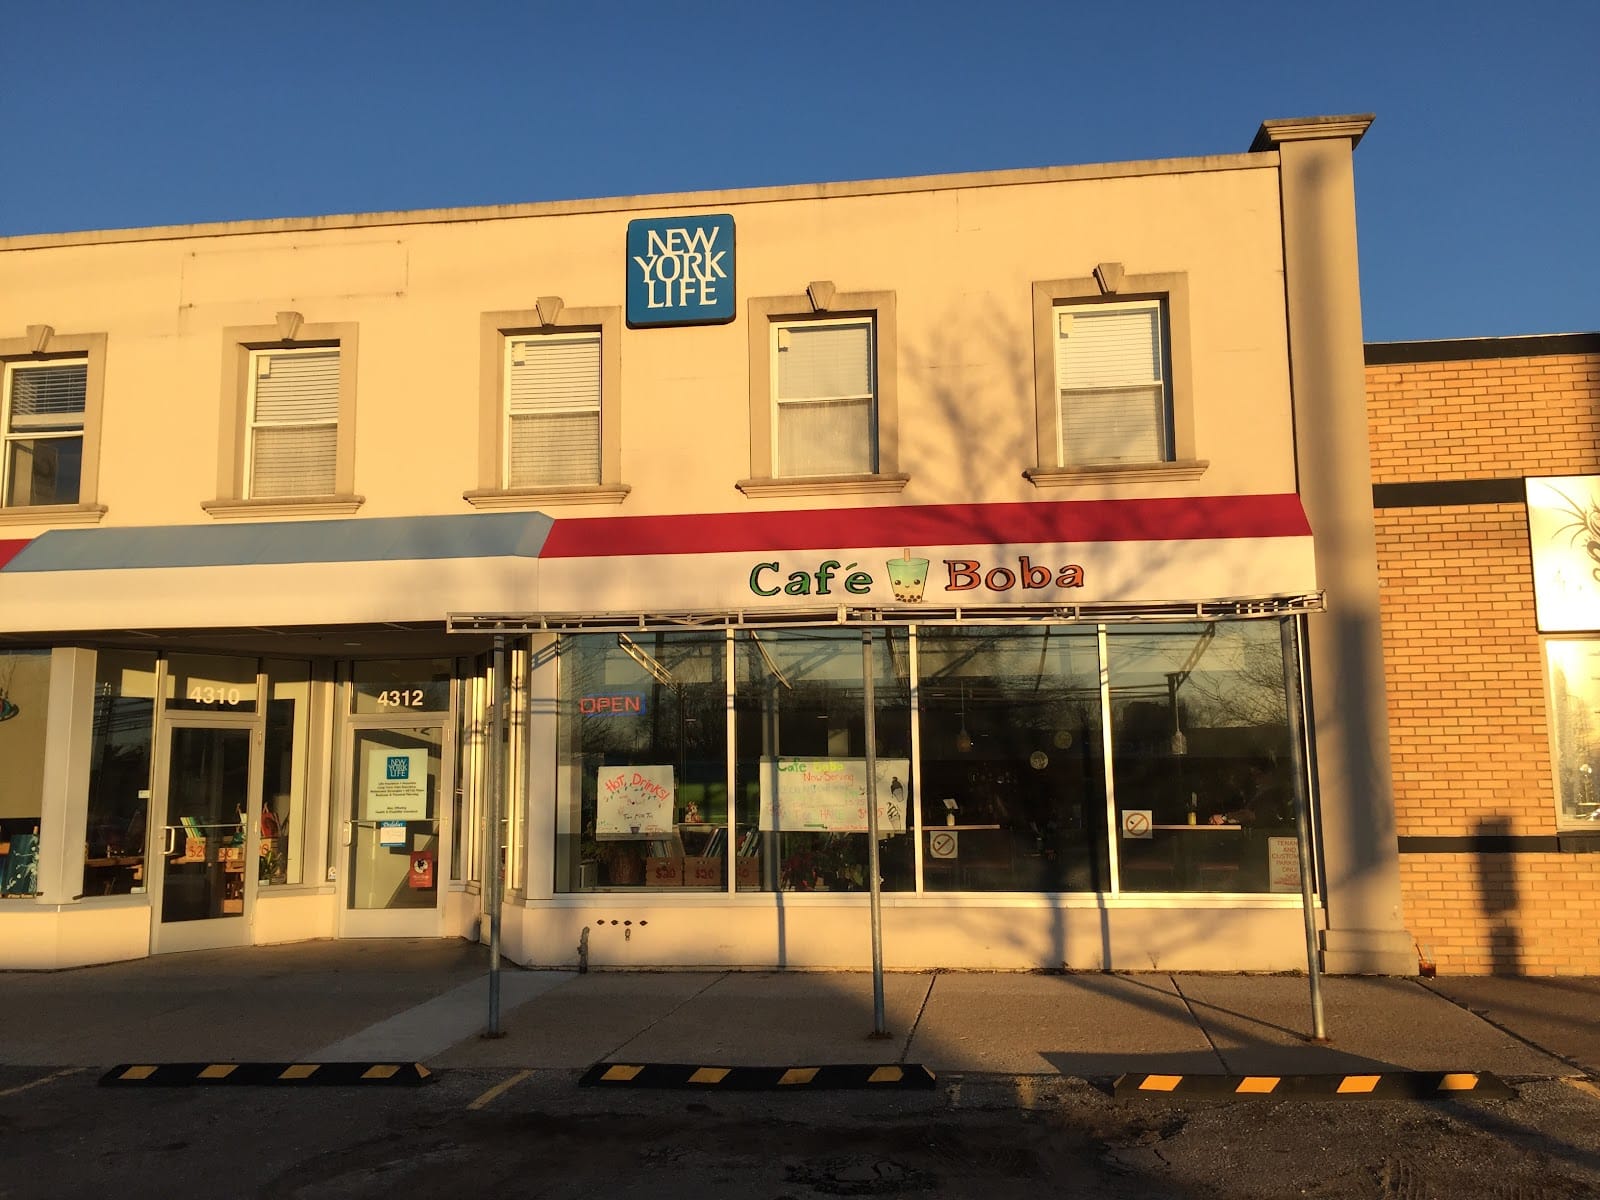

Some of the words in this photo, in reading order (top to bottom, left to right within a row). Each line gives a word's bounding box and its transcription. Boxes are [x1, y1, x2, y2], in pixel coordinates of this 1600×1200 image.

[646, 226, 720, 257] NEW
[632, 251, 728, 283] YORK
[647, 279, 718, 309] LIFE
[749, 560, 874, 597] Café
[943, 555, 1085, 592] Boba
[190, 686, 241, 706] 4310
[376, 689, 424, 707] 4312
[579, 695, 640, 715] OPEN
[776, 757, 807, 773] Cafe
